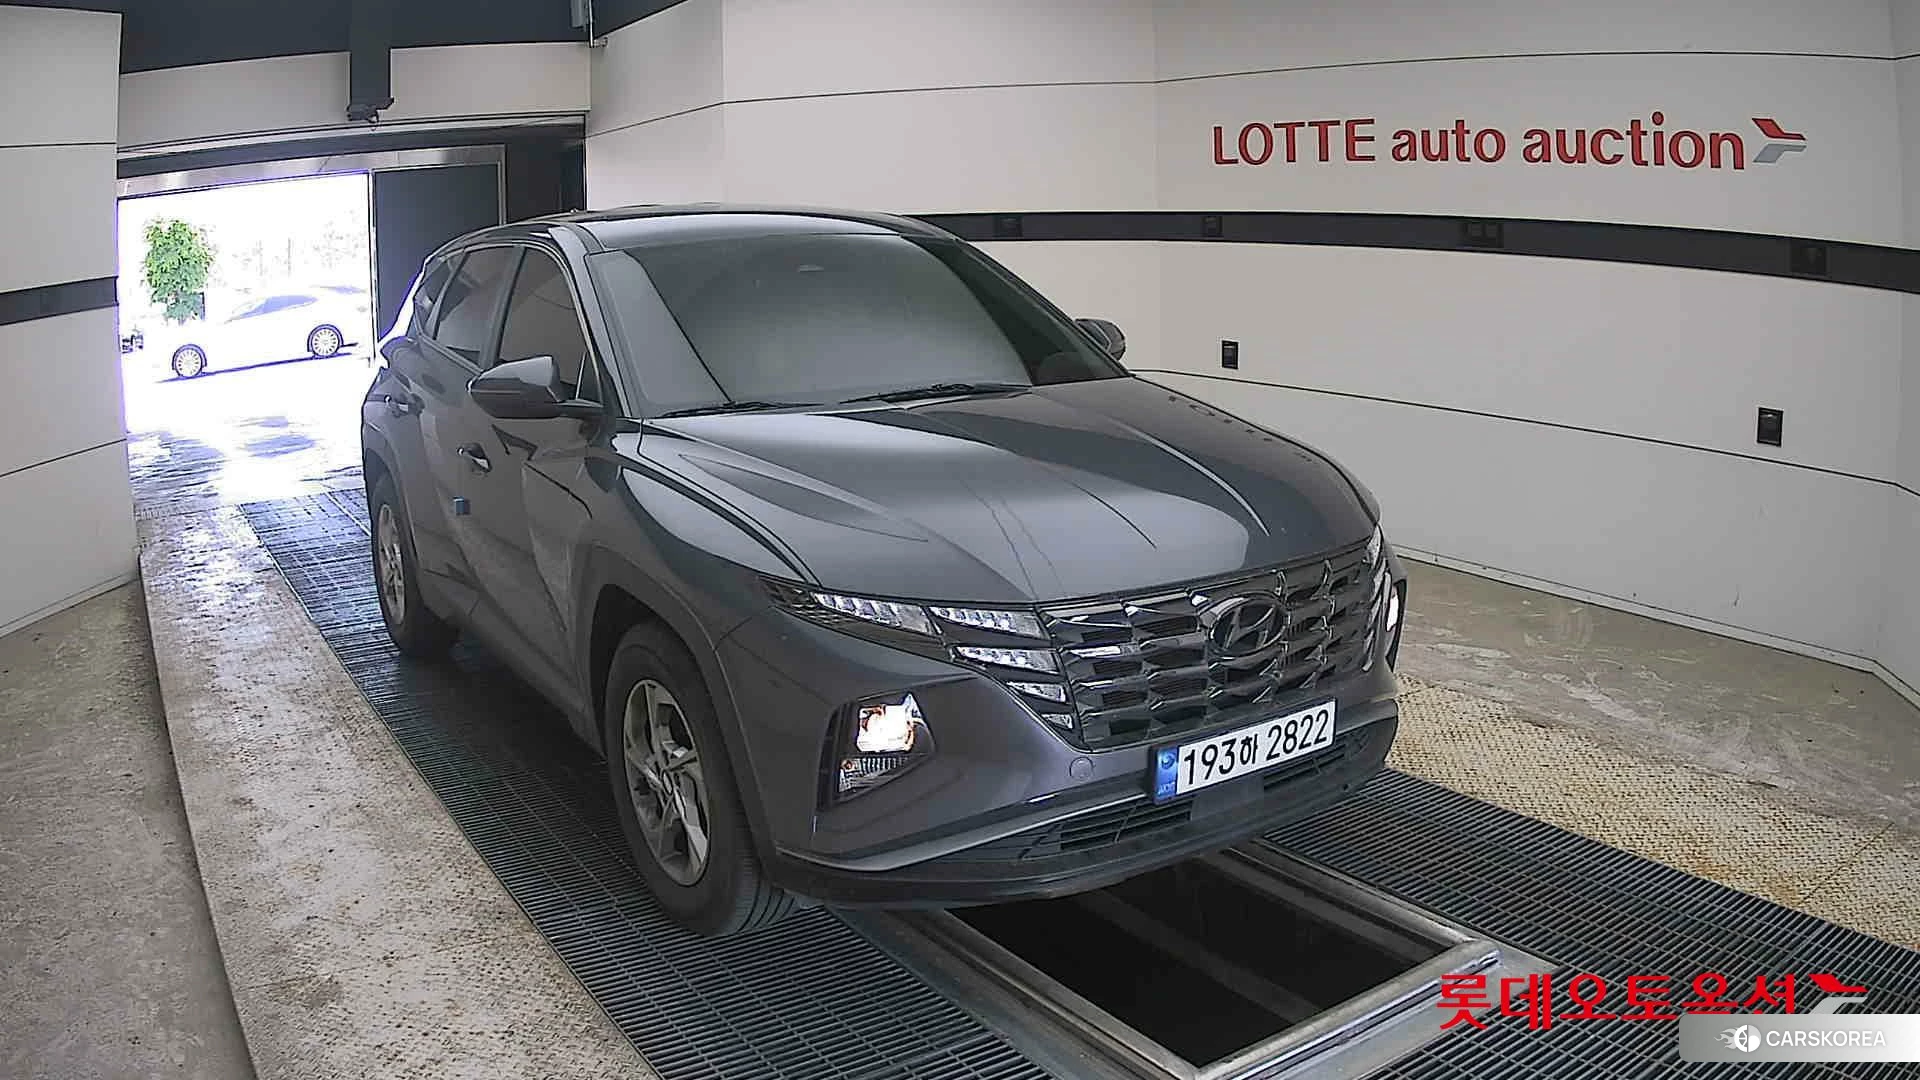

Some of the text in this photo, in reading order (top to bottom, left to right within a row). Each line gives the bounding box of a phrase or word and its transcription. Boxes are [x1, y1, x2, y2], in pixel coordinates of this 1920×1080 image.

[1212, 111, 1744, 170] LOTTE auto auction
[1183, 709, 1329, 785] 193하 2822
